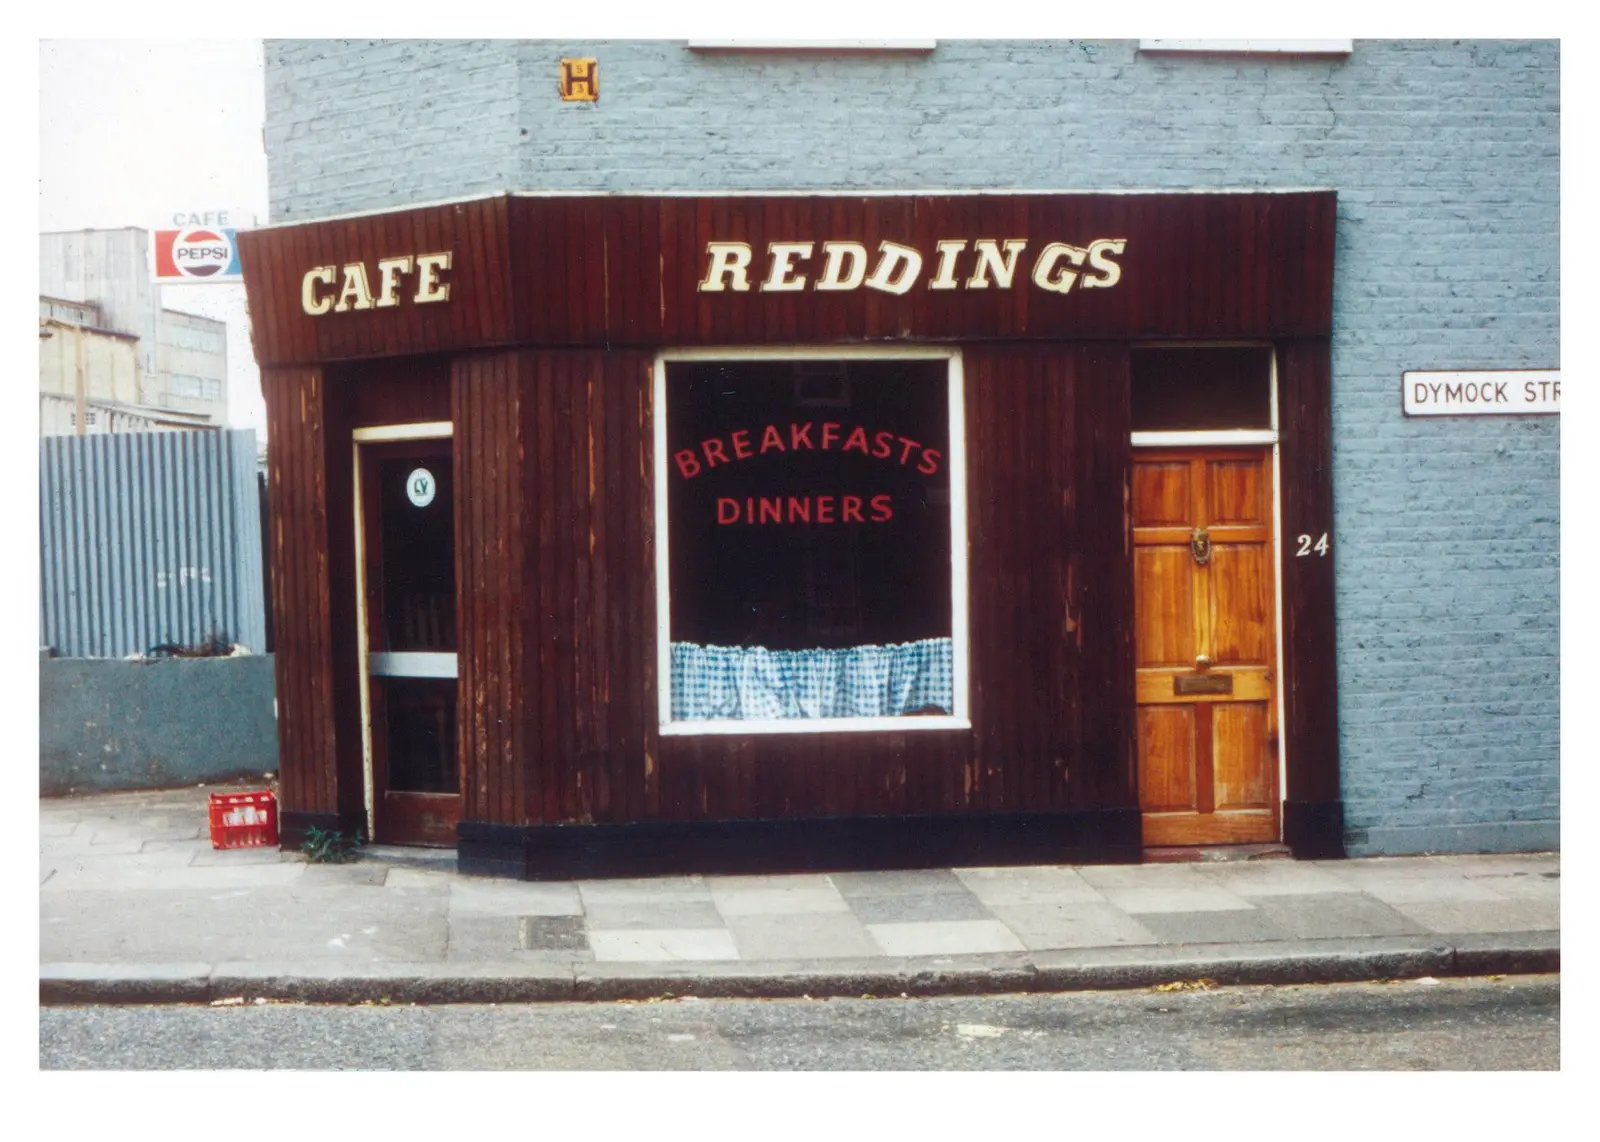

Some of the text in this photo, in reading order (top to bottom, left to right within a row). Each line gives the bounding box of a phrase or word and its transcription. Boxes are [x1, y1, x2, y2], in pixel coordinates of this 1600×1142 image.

[565, 62, 595, 96] H
[172, 211, 229, 227] CAFE
[177, 247, 228, 260] PEPSI
[697, 239, 1128, 296] REDDINGS
[302, 251, 453, 316] CAFE
[1414, 381, 1508, 404] DYMOCK
[673, 422, 942, 480] BREAKFASTS
[717, 495, 893, 525] DINNERS
[1295, 532, 1330, 557] 24
